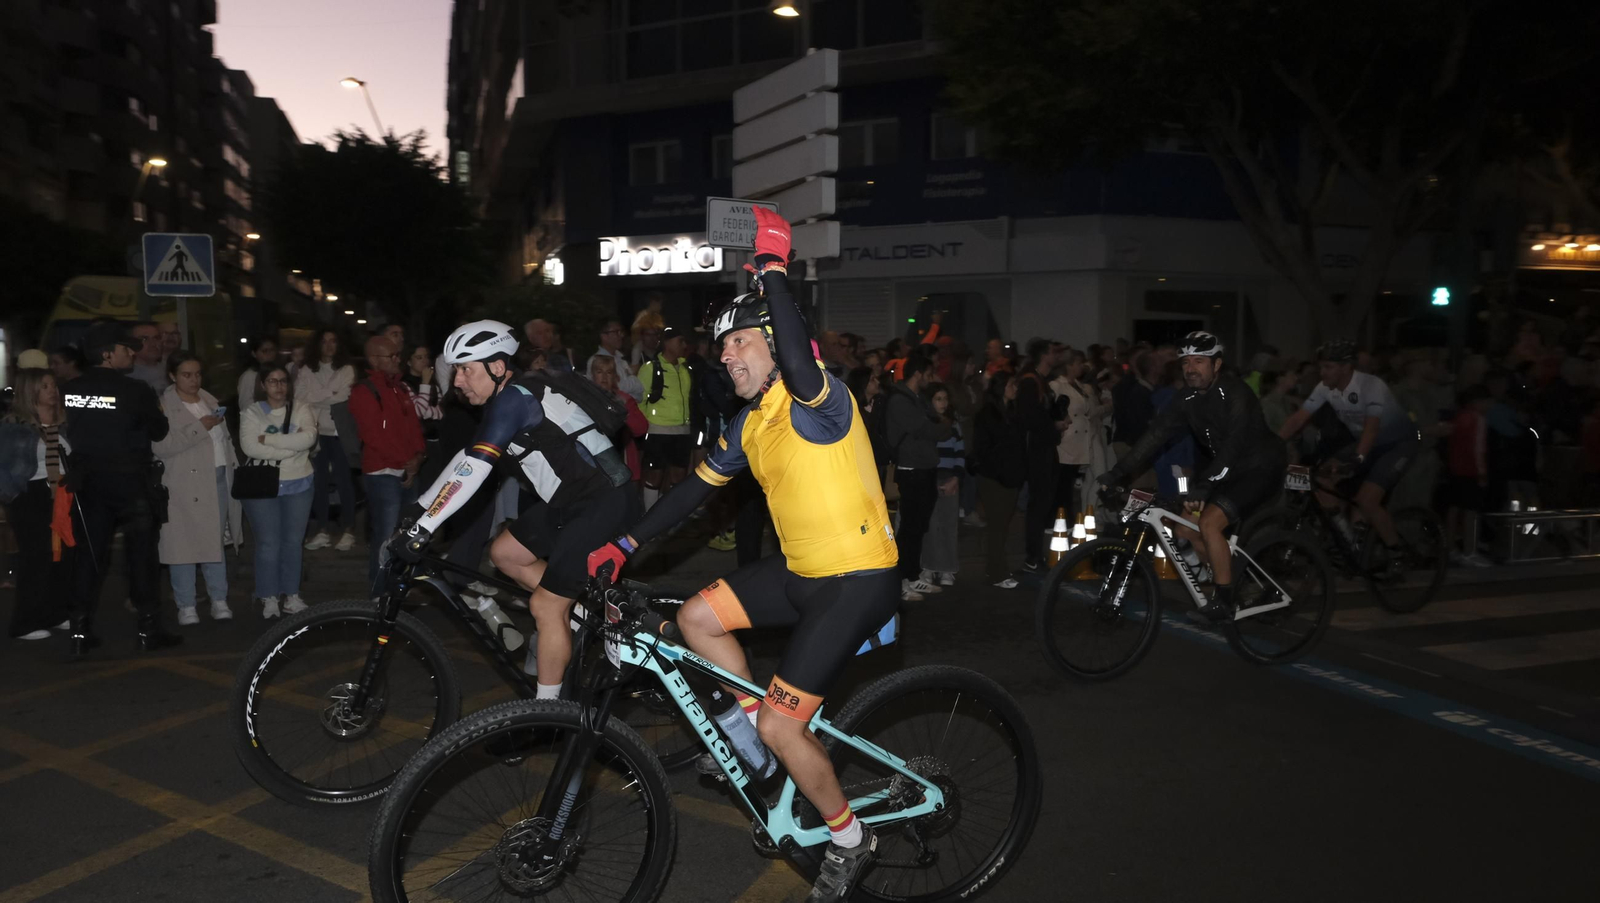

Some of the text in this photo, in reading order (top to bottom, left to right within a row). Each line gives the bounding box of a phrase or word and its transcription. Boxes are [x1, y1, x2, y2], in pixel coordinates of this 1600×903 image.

[723, 217, 757, 231] FEDERIC
[729, 206, 754, 215] AVEN
[712, 229, 743, 244] GARCÍA
[844, 242, 964, 261] TALDENT
[1161, 531, 1203, 594] megamo
[682, 651, 715, 669] NITRON
[444, 720, 512, 756] KENDA
[667, 671, 750, 788] Bianchi
[549, 792, 577, 840] ROCKSHOX
[960, 856, 1005, 898] KENDA
